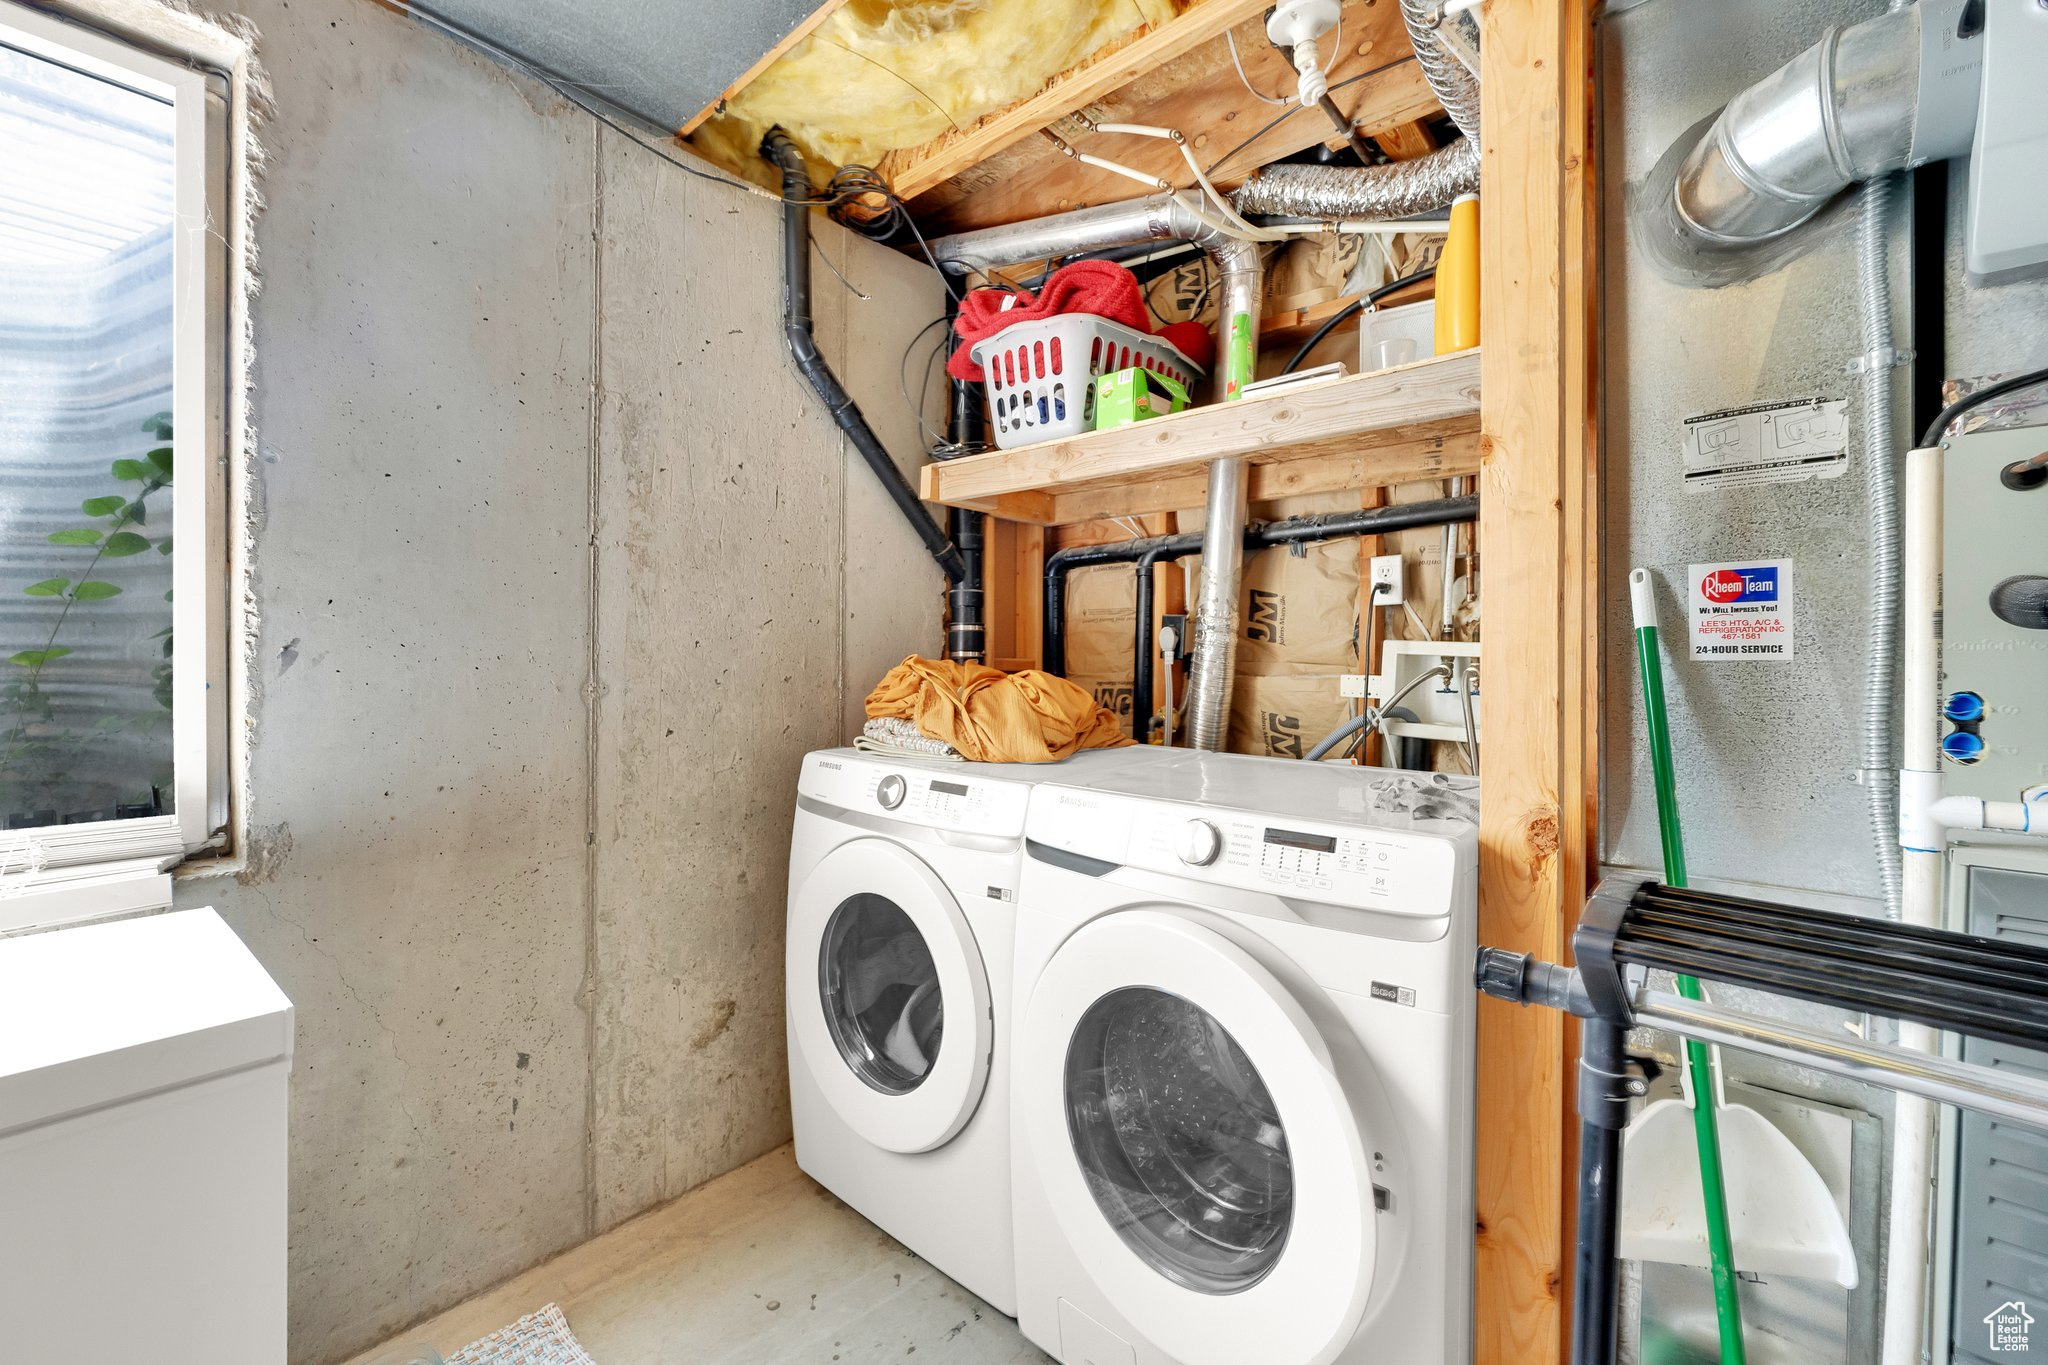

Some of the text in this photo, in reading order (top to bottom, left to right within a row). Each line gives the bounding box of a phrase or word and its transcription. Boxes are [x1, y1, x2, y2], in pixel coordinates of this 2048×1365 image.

[1763, 414, 1771, 424] 2
[1689, 426, 1694, 436] 1
[1705, 571, 1773, 598] Rheem Team
[1729, 619, 1752, 627] HTG,
[1698, 626, 1767, 634] REFRIGERATION
[1696, 645, 1784, 654] 24-HOUR SERVICE
[818, 760, 842, 771] SAMSUNG
[1059, 795, 1100, 809] SAMSUNG
